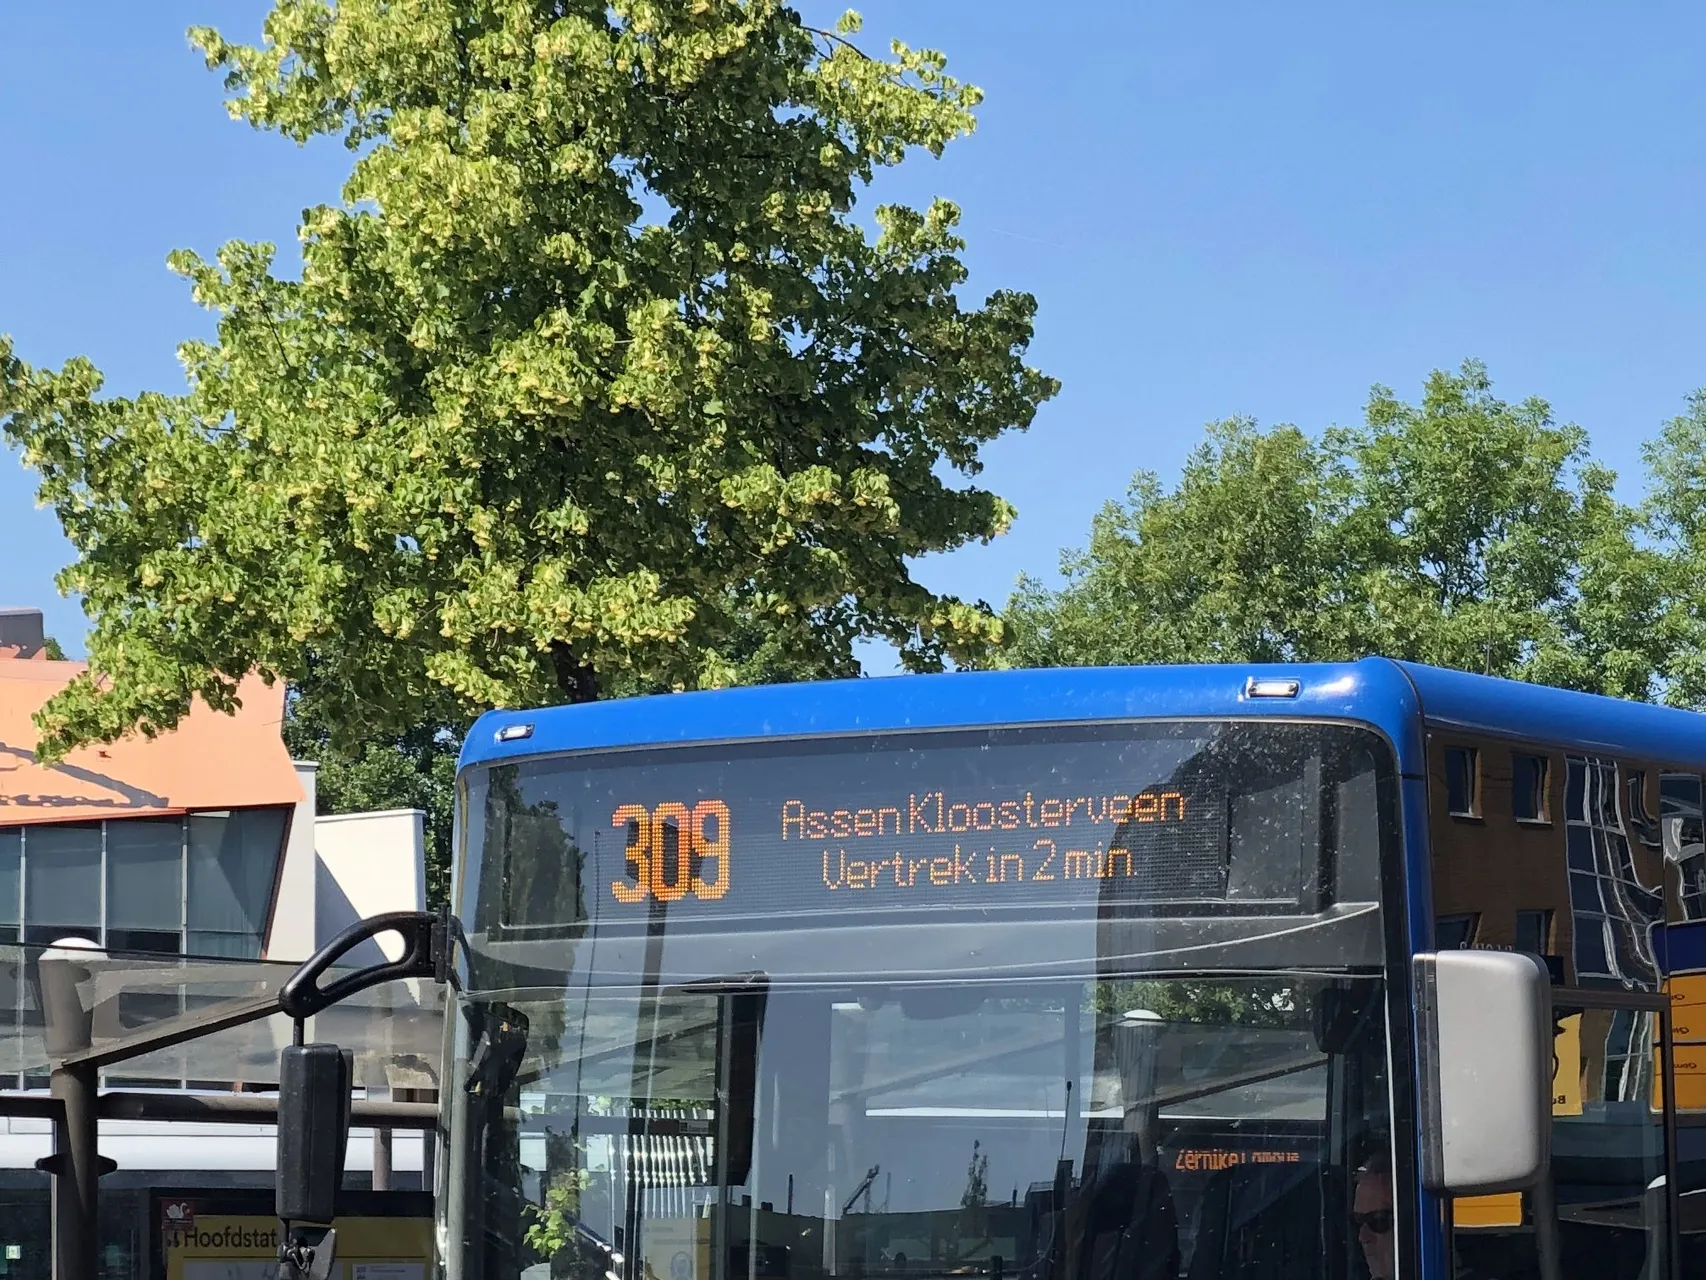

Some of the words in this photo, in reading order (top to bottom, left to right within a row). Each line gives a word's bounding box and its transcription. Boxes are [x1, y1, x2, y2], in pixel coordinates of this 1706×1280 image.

[782, 799, 900, 840] Assen
[908, 791, 1185, 833] Kloosterveen
[612, 800, 730, 902] 309
[823, 844, 977, 889] Vertrek
[986, 846, 1024, 882] in
[1033, 839, 1055, 881] 2
[1064, 840, 1133, 880] min
